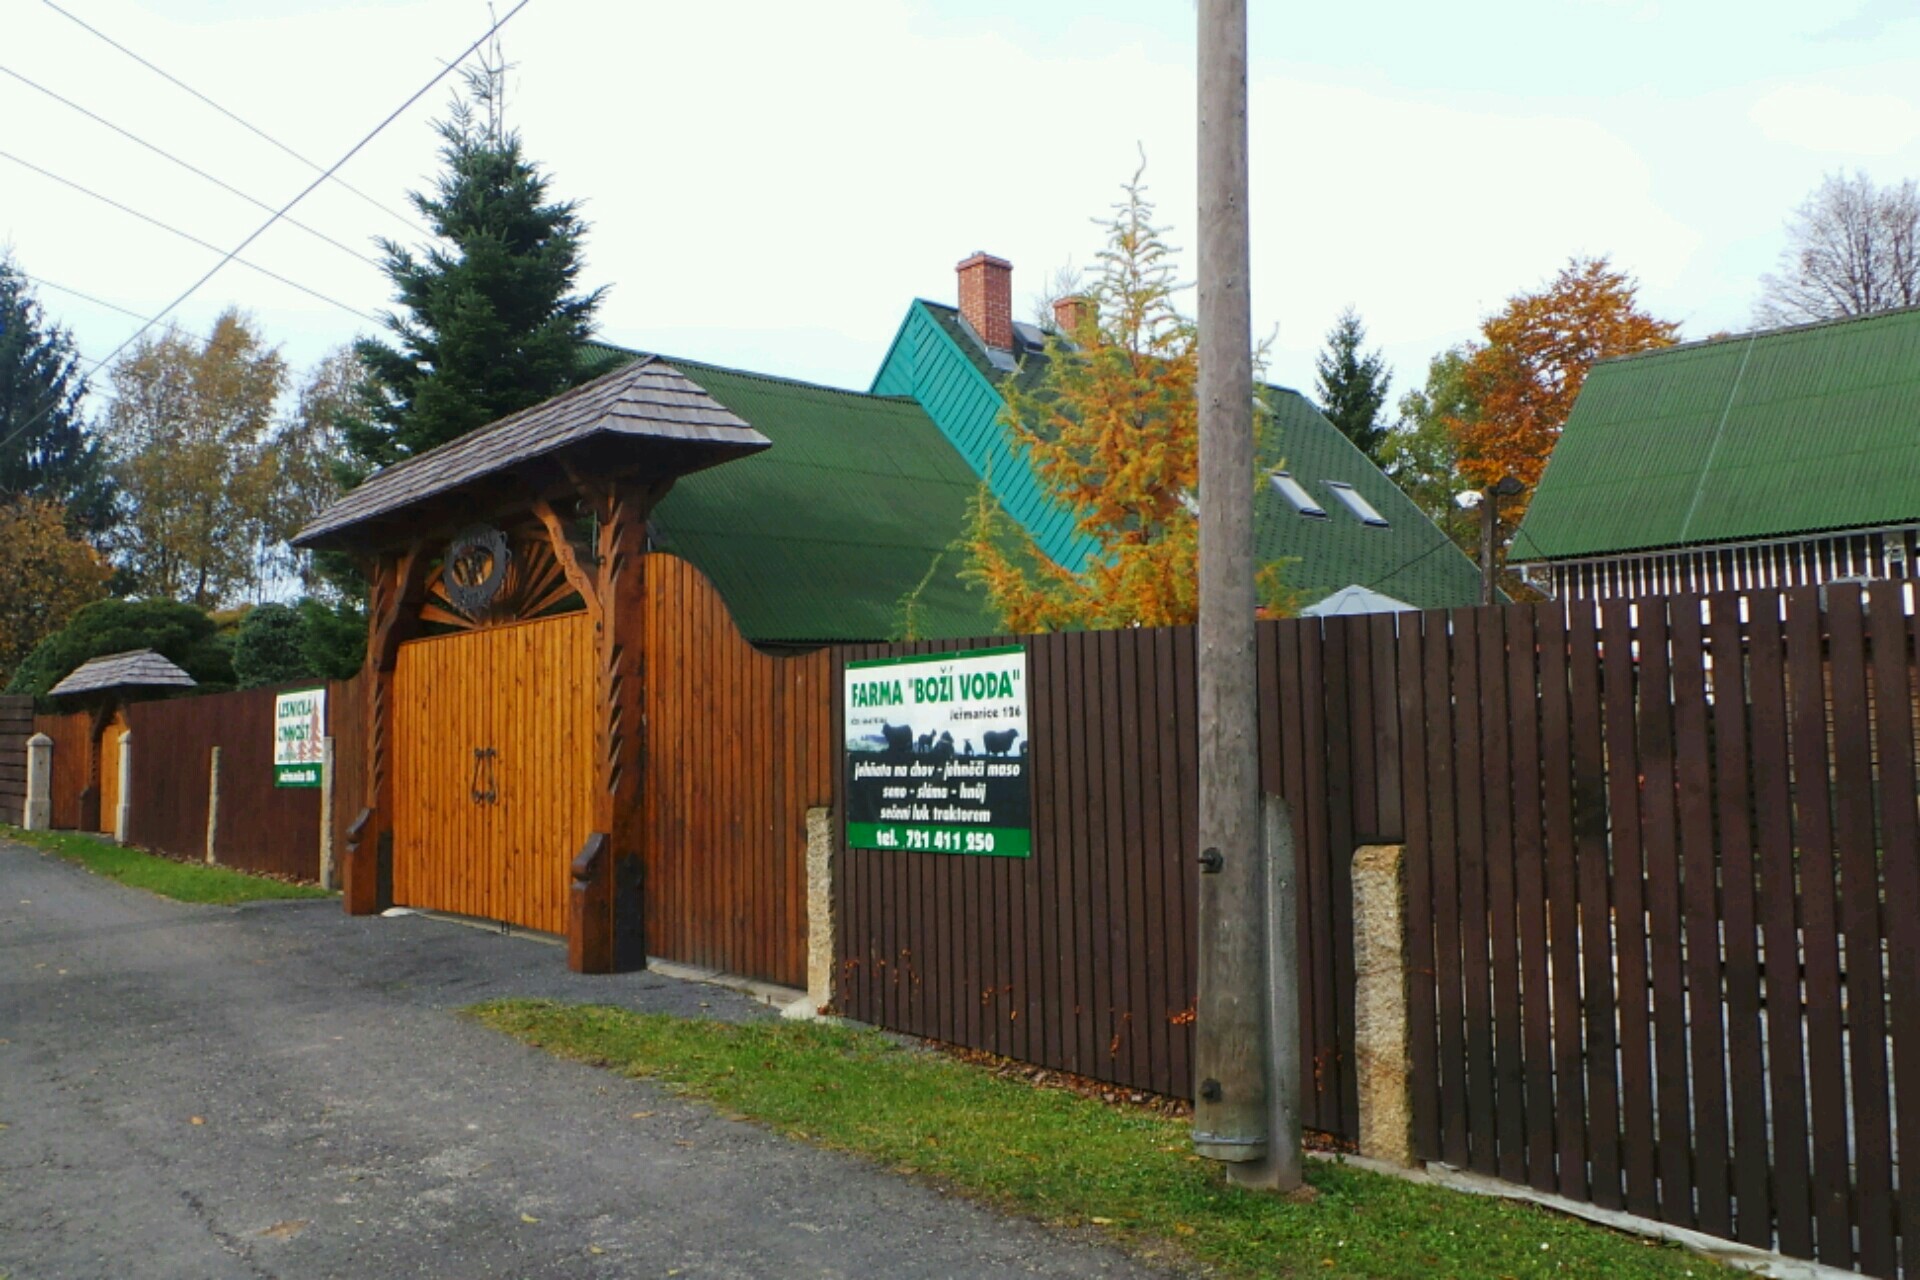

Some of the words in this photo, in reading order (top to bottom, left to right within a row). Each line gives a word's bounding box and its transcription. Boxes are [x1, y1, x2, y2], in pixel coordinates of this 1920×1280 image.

[852, 679, 904, 708] FARMA
[908, 665, 955, 705] "BOŽÍ
[959, 668, 1021, 701] VODA"
[894, 766, 908, 777] na
[910, 760, 935, 777] chov
[987, 764, 1021, 777] maso
[882, 786, 908, 799] seno
[916, 782, 949, 799] sláma
[959, 782, 986, 804] hnůj
[912, 803, 930, 821] luk
[933, 804, 991, 822] traktorem
[876, 827, 899, 847] tel.
[933, 830, 961, 850] 411
[965, 831, 995, 852] 250
